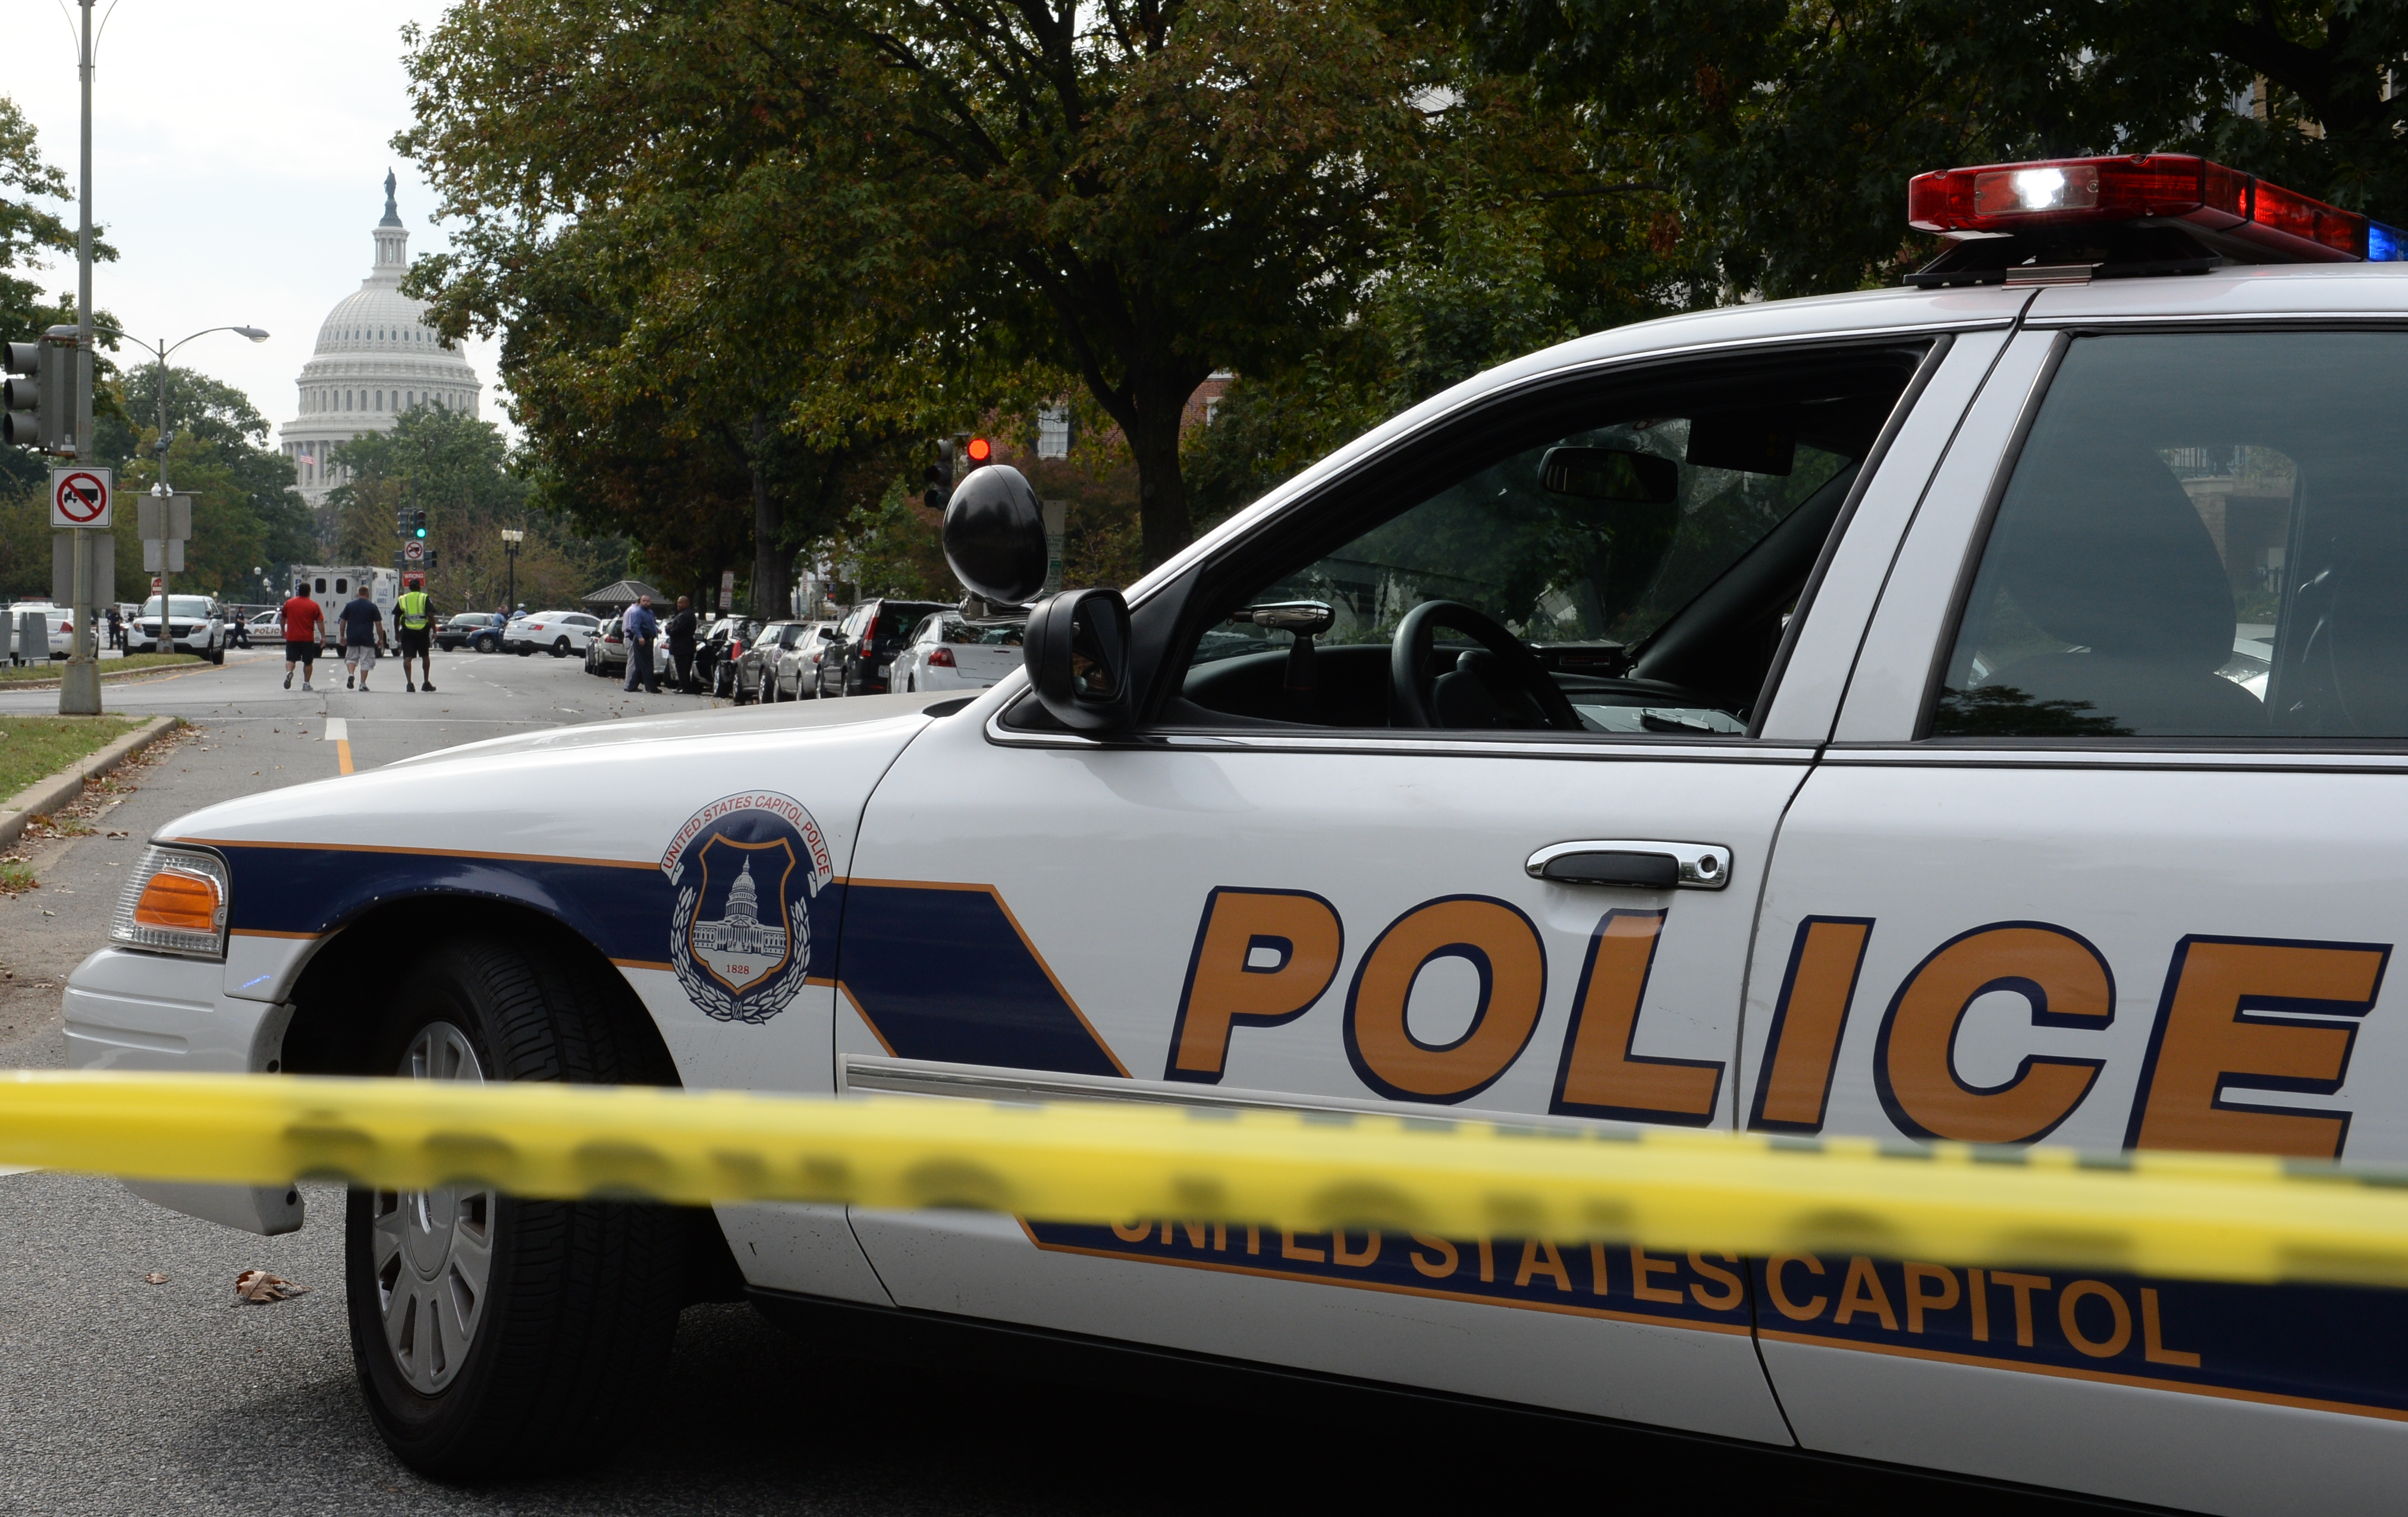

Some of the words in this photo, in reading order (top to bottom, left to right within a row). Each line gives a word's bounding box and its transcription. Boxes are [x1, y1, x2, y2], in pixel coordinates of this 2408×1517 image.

[663, 818, 701, 869] UNITED
[704, 796, 752, 822] STATES
[755, 796, 802, 826] CAPITOL
[801, 821, 830, 877] POLICE
[726, 964, 749, 975] 1828
[1163, 885, 2394, 1167] POLICE
[1766, 1249, 2200, 1368] CAPITOL
